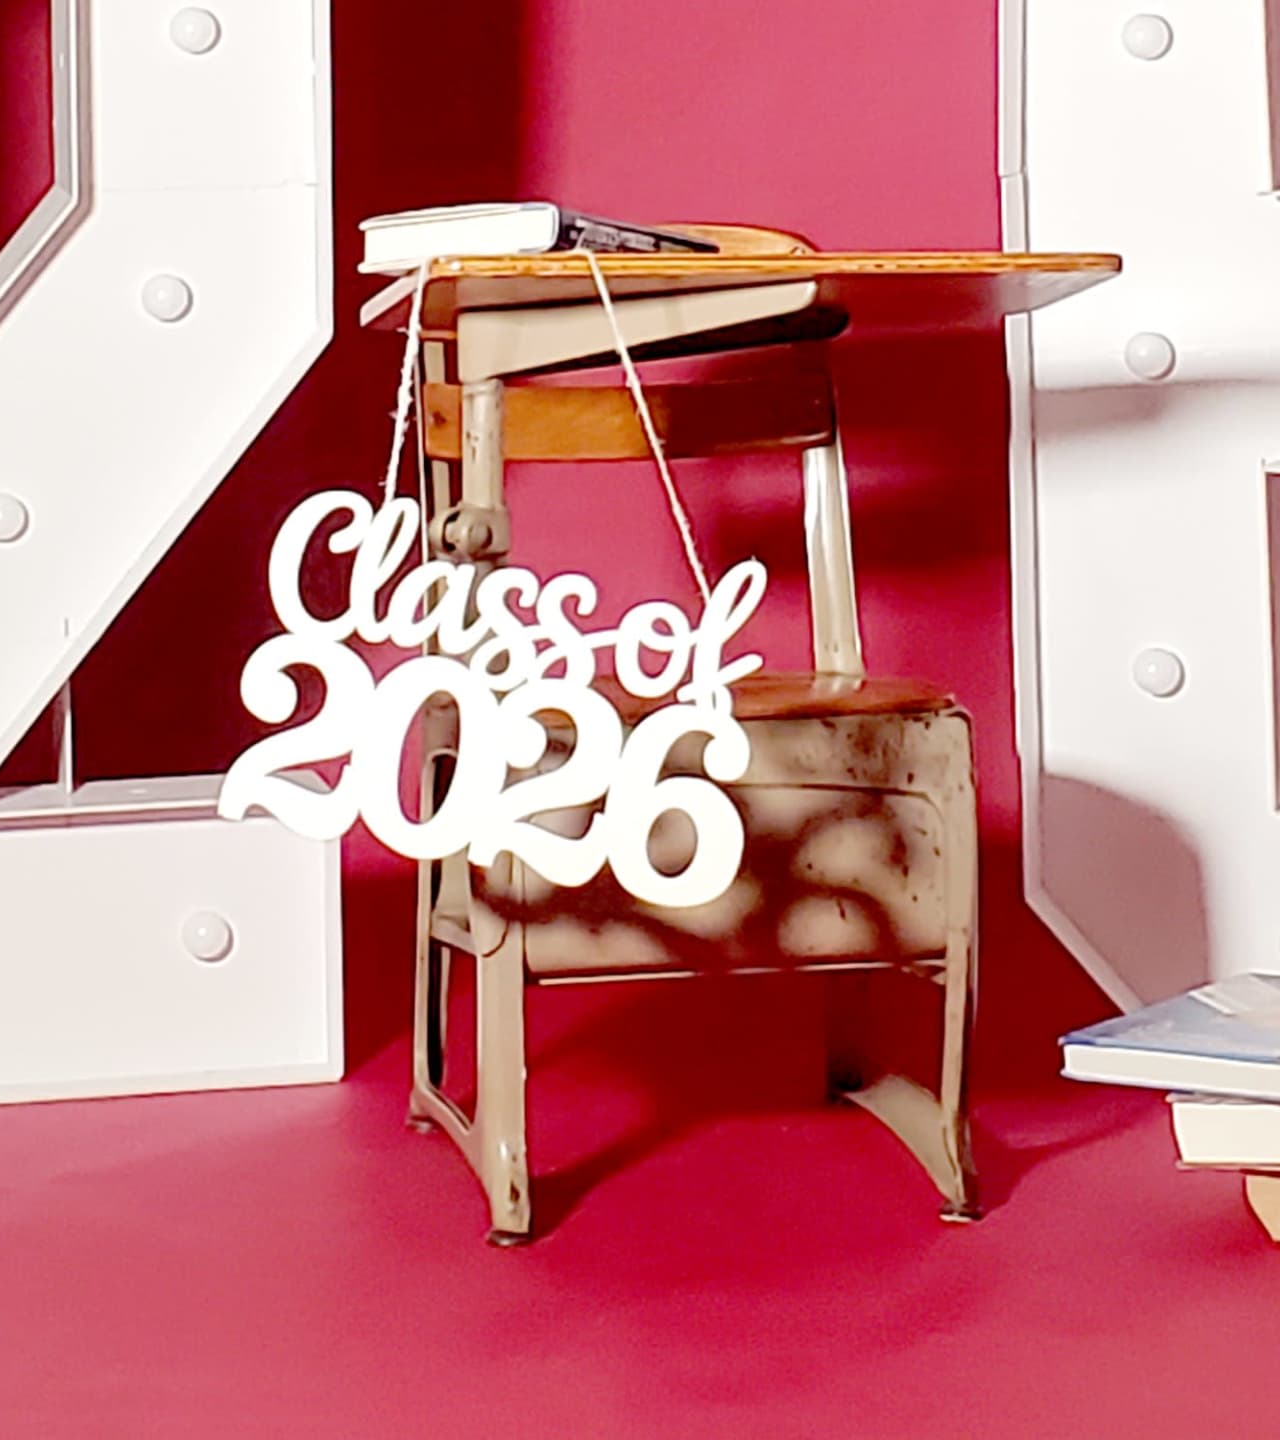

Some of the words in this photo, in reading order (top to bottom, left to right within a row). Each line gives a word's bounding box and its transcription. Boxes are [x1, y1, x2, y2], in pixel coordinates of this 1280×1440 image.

[268, 490, 597, 691] Class
[616, 559, 767, 715] of
[217, 632, 750, 908] 2026
